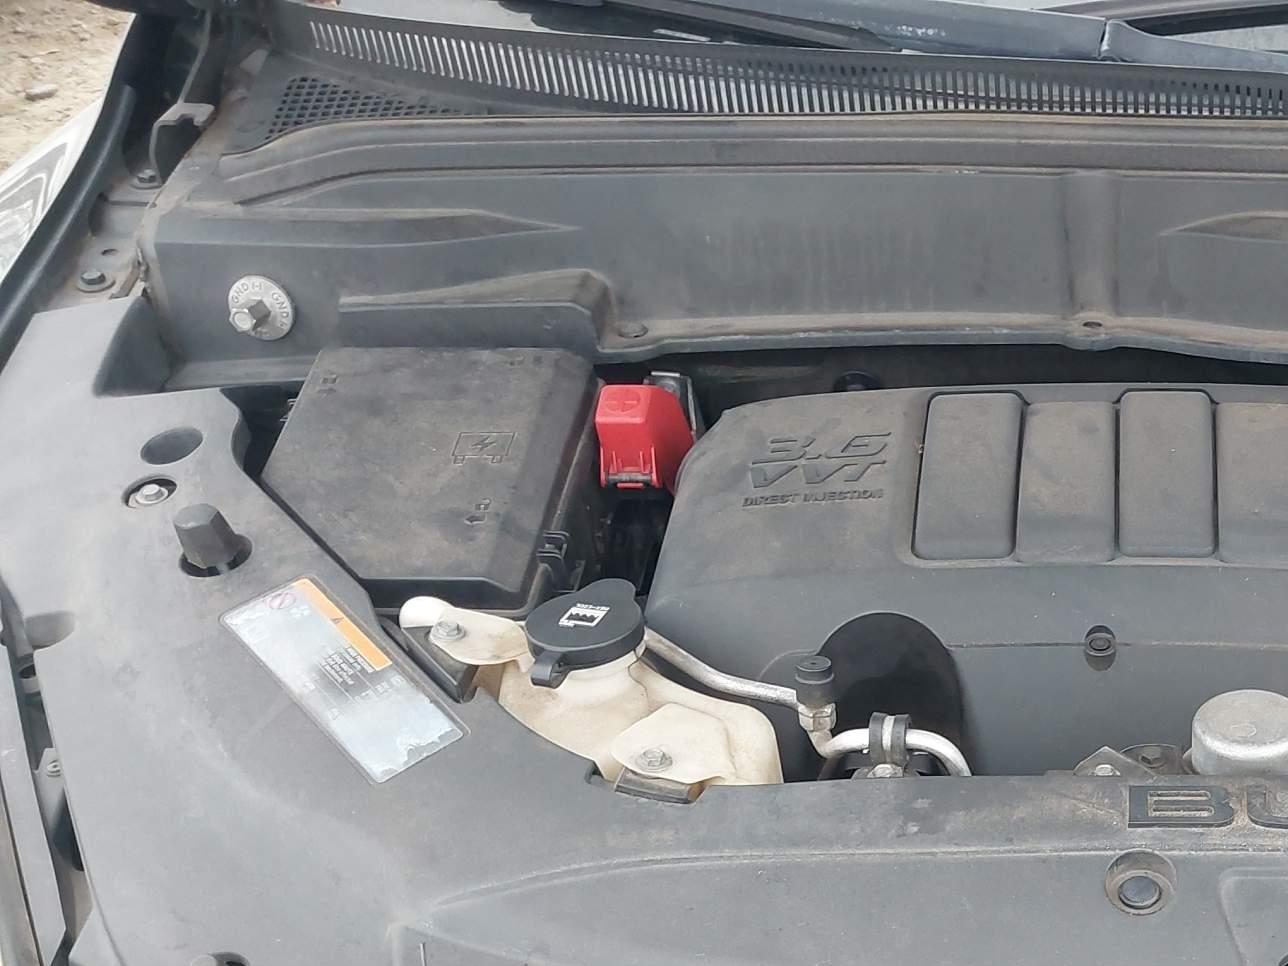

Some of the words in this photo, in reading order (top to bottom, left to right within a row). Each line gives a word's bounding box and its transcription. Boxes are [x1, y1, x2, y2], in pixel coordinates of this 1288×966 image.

[752, 432, 892, 465] 3.6
[751, 460, 887, 488] VVT
[742, 493, 799, 507] DIRECT
[803, 489, 884, 503] INJECTION
